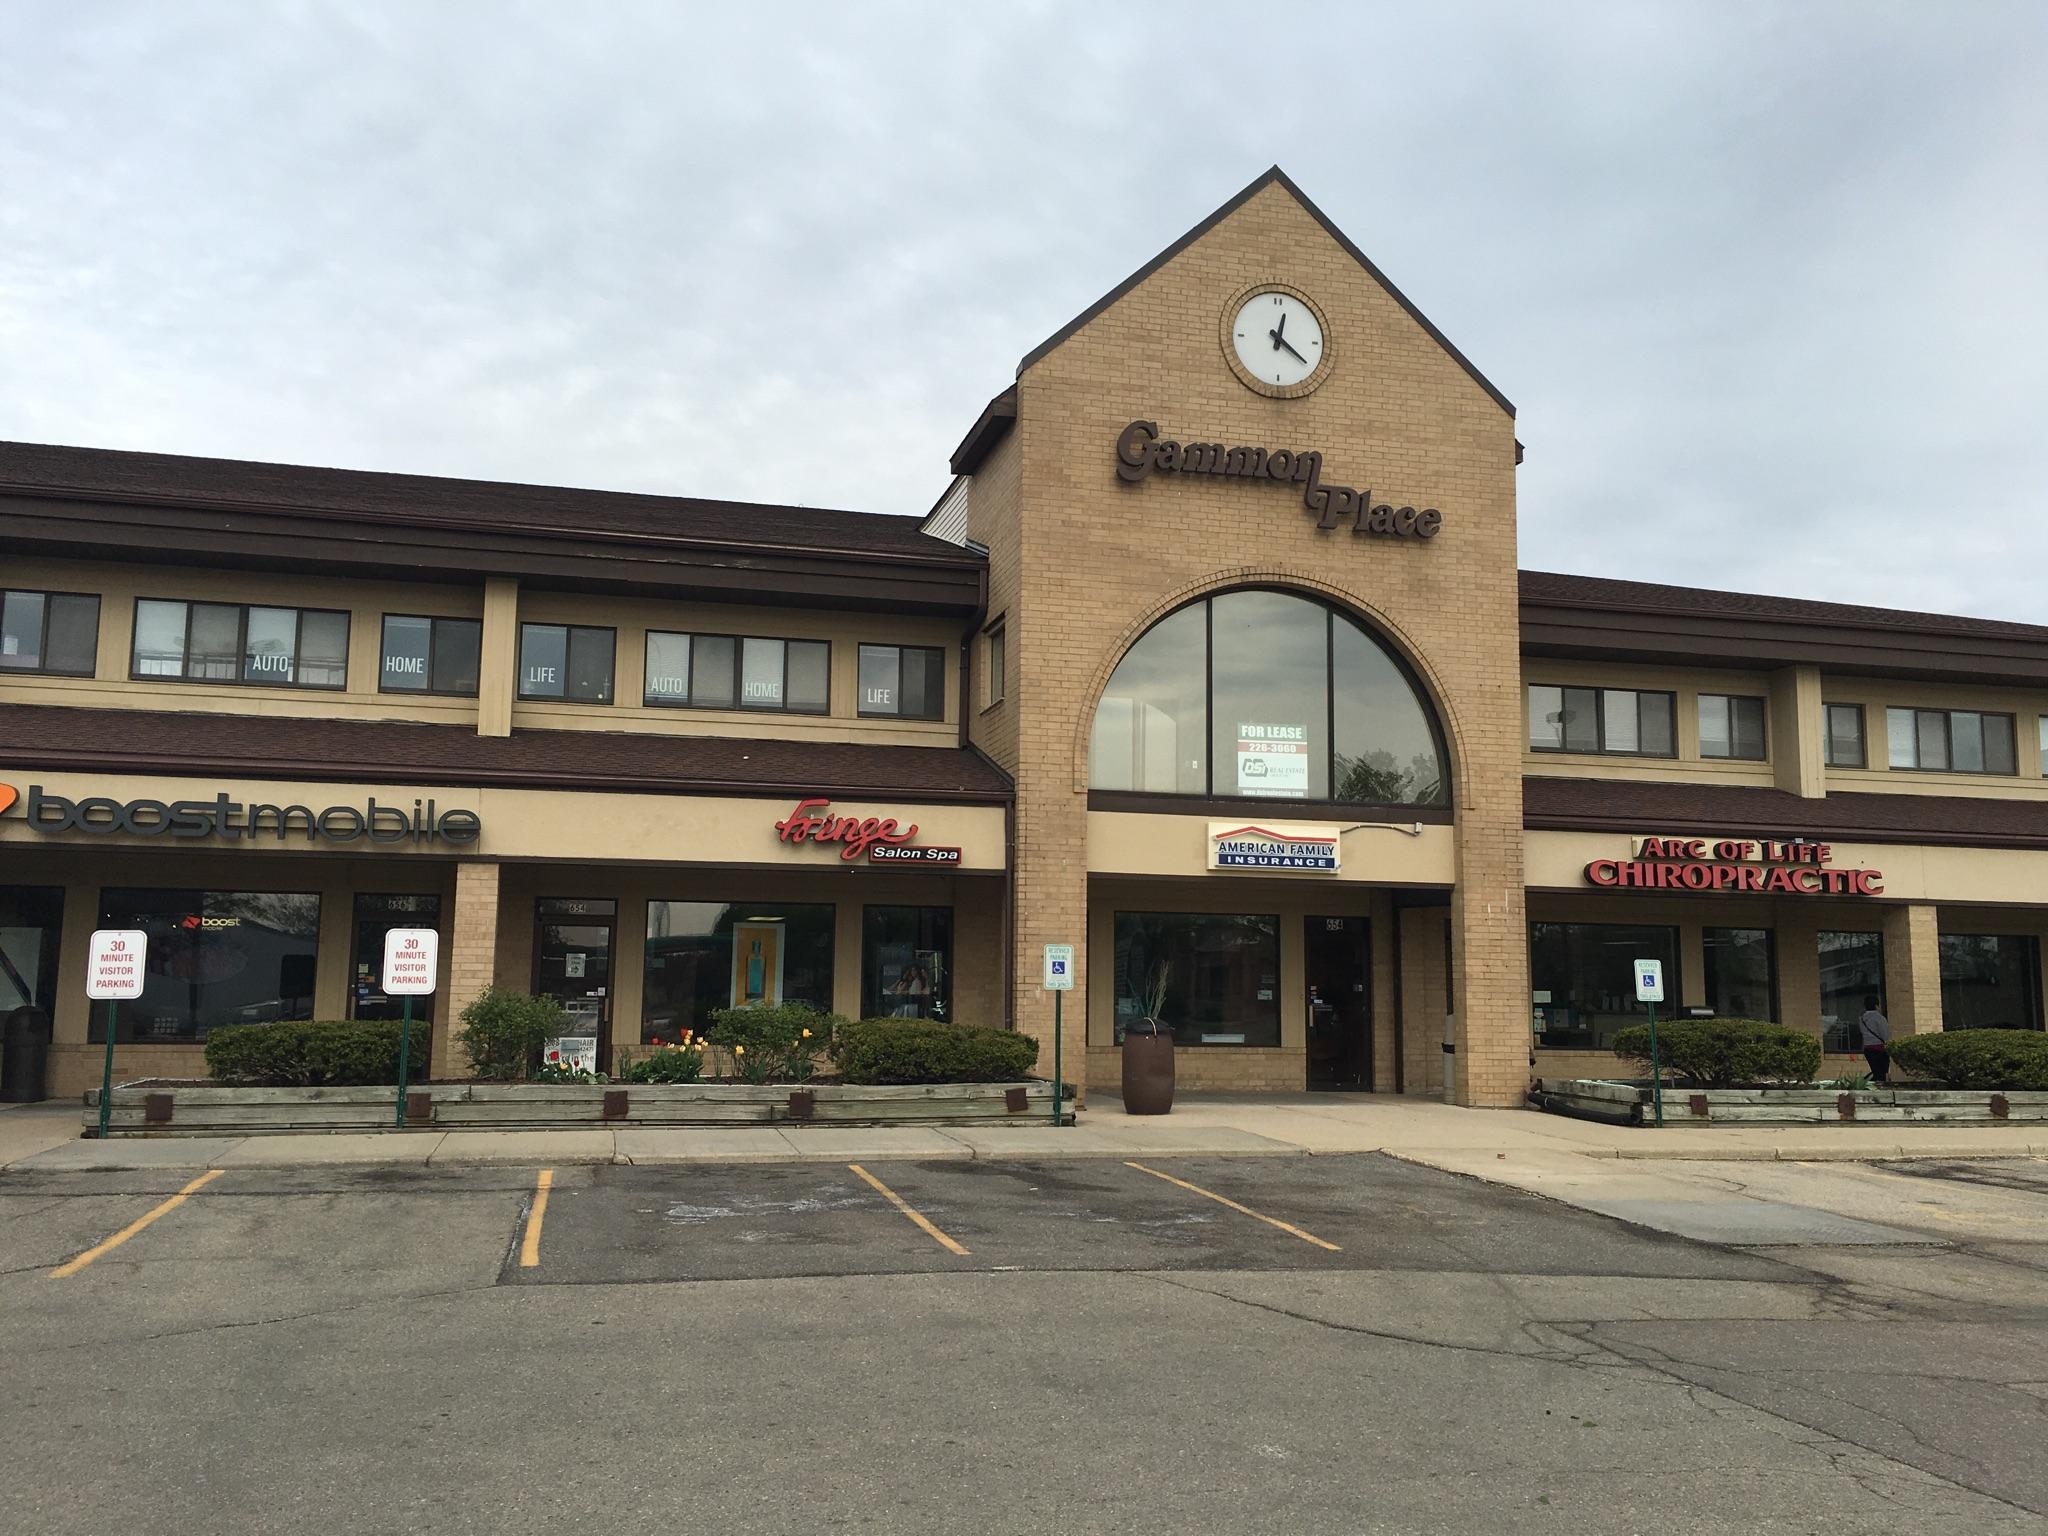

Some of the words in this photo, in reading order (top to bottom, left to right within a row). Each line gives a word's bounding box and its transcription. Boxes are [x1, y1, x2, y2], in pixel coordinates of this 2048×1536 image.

[1116, 420, 1323, 510] Gammon
[1316, 484, 1443, 538] Place
[252, 655, 289, 673] AUTO
[385, 656, 425, 675] HOME
[529, 666, 556, 684] LIFE
[651, 677, 683, 694] AUTO
[745, 682, 779, 698] HOME
[867, 688, 891, 704] LIFE
[1241, 725, 1265, 737] FOR
[1267, 727, 1303, 739] LEASE
[872, 847, 923, 860] Salon
[925, 848, 959, 863] Spa
[1218, 841, 1286, 854] AMERICAN
[1289, 844, 1335, 856] FAMILY
[1643, 837, 1707, 859] ARC
[1713, 840, 1755, 861] OF
[1762, 841, 1834, 864] LIFE
[1227, 856, 1327, 867] INSURANCE
[1583, 859, 1885, 895] CHIROPRACTIC
[568, 904, 586, 913] 654
[202, 917, 241, 927] boost
[110, 941, 126, 952] 30
[404, 939, 419, 950] 30
[101, 953, 135, 962] MINUTE
[395, 951, 427, 960] MINUTE
[99, 966, 134, 975] VISITOR
[394, 963, 427, 972] VISITOR
[96, 979, 135, 988] PARKING
[391, 976, 428, 985] PARKING
